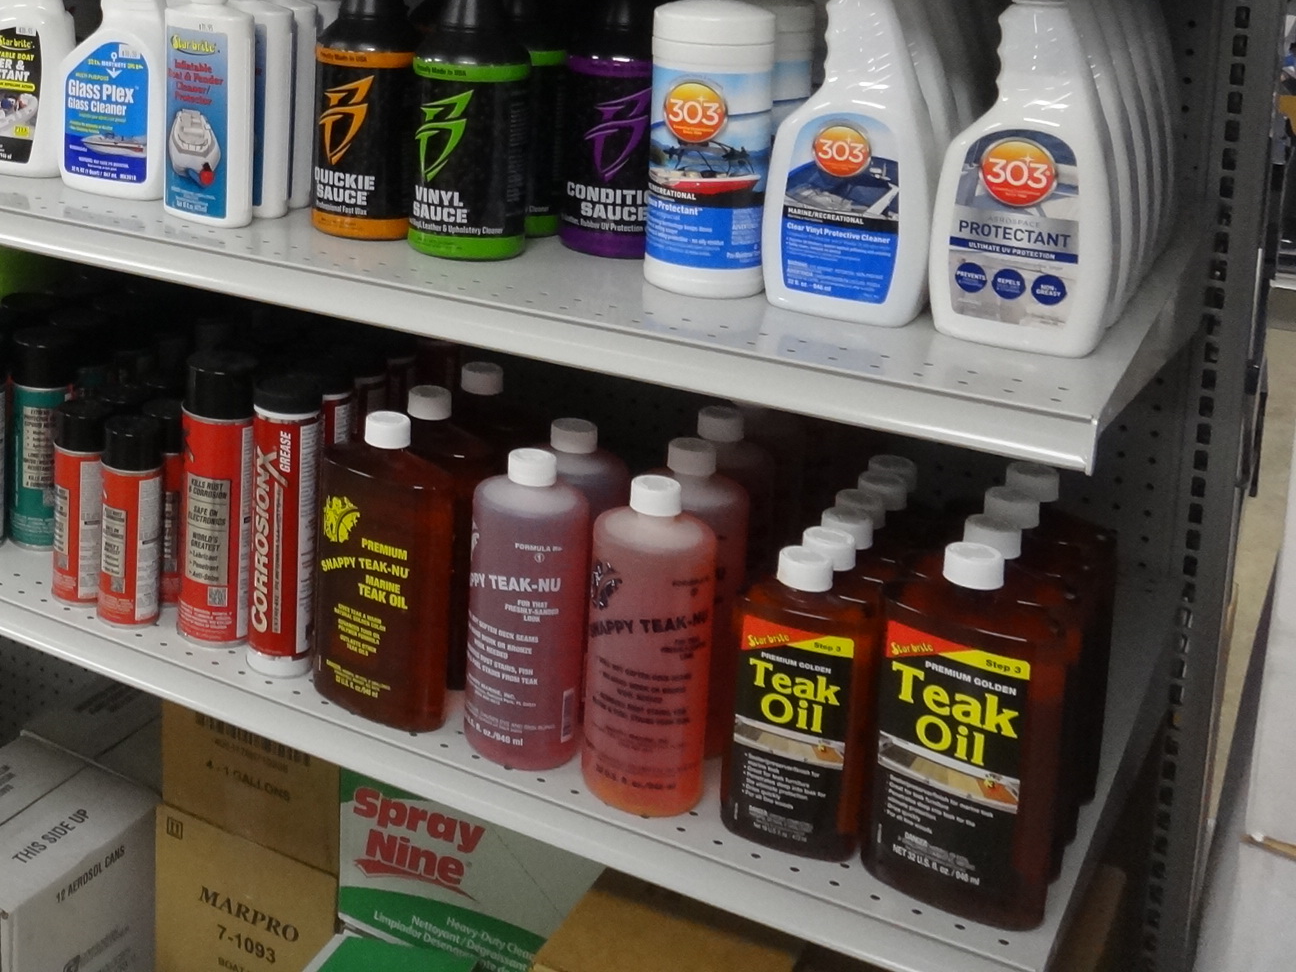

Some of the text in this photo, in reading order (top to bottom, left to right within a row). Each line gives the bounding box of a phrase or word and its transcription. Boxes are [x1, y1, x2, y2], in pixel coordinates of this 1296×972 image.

[16, 60, 25, 70] &
[175, 59, 213, 73] Inflatable
[194, 72, 224, 86] Fender
[69, 79, 134, 104] Glass Plex
[68, 96, 127, 116] Glass Cleaner
[668, 98, 721, 127] 303
[818, 140, 864, 163] 303
[315, 166, 376, 191] QUICKIE
[987, 156, 1048, 189] 303
[316, 184, 368, 206] SAUCE
[415, 184, 464, 208] VINYL
[412, 201, 468, 224] SAUCE
[787, 206, 865, 225] MARINE/RECREATIONAL
[786, 221, 891, 244] Clear Protective Cleaner
[958, 219, 1072, 248] PROTECTANT
[968, 240, 1056, 260] ULTIMATE PROTECTION
[279, 430, 292, 474] GREASE
[193, 487, 228, 500] CORROSION
[190, 539, 221, 552] GREATEST
[361, 536, 408, 561] PREMIUM
[514, 541, 551, 553] FORMULA
[321, 557, 409, 579] SNAPPY TEAK-NU
[365, 574, 401, 594] MARINE
[489, 573, 562, 593] TEAK-NU
[357, 583, 408, 611] TEAK OIL
[515, 632, 539, 644] SEAMS
[813, 640, 834, 652] Step
[761, 650, 832, 675] PREMIUM GOLDEN
[985, 657, 1011, 672] Step
[520, 676, 538, 686] TEAK
[749, 657, 842, 707] Teak
[925, 659, 1018, 697] PREMIUM GOLDEN
[891, 660, 1020, 740] Teak
[760, 693, 823, 734] Oil
[915, 714, 986, 767] Oil
[232, 769, 292, 803] GALLONS
[353, 786, 486, 854] Spray
[12, 807, 91, 866] THIS SIDE UP
[364, 829, 466, 885] Nine
[892, 843, 916, 862] NET 32
[55, 844, 127, 904] 12 AEROSOL CANS
[200, 885, 301, 944] MARPRO
[410, 914, 460, 947] Nettoyant
[216, 925, 277, 965] 7-1093
